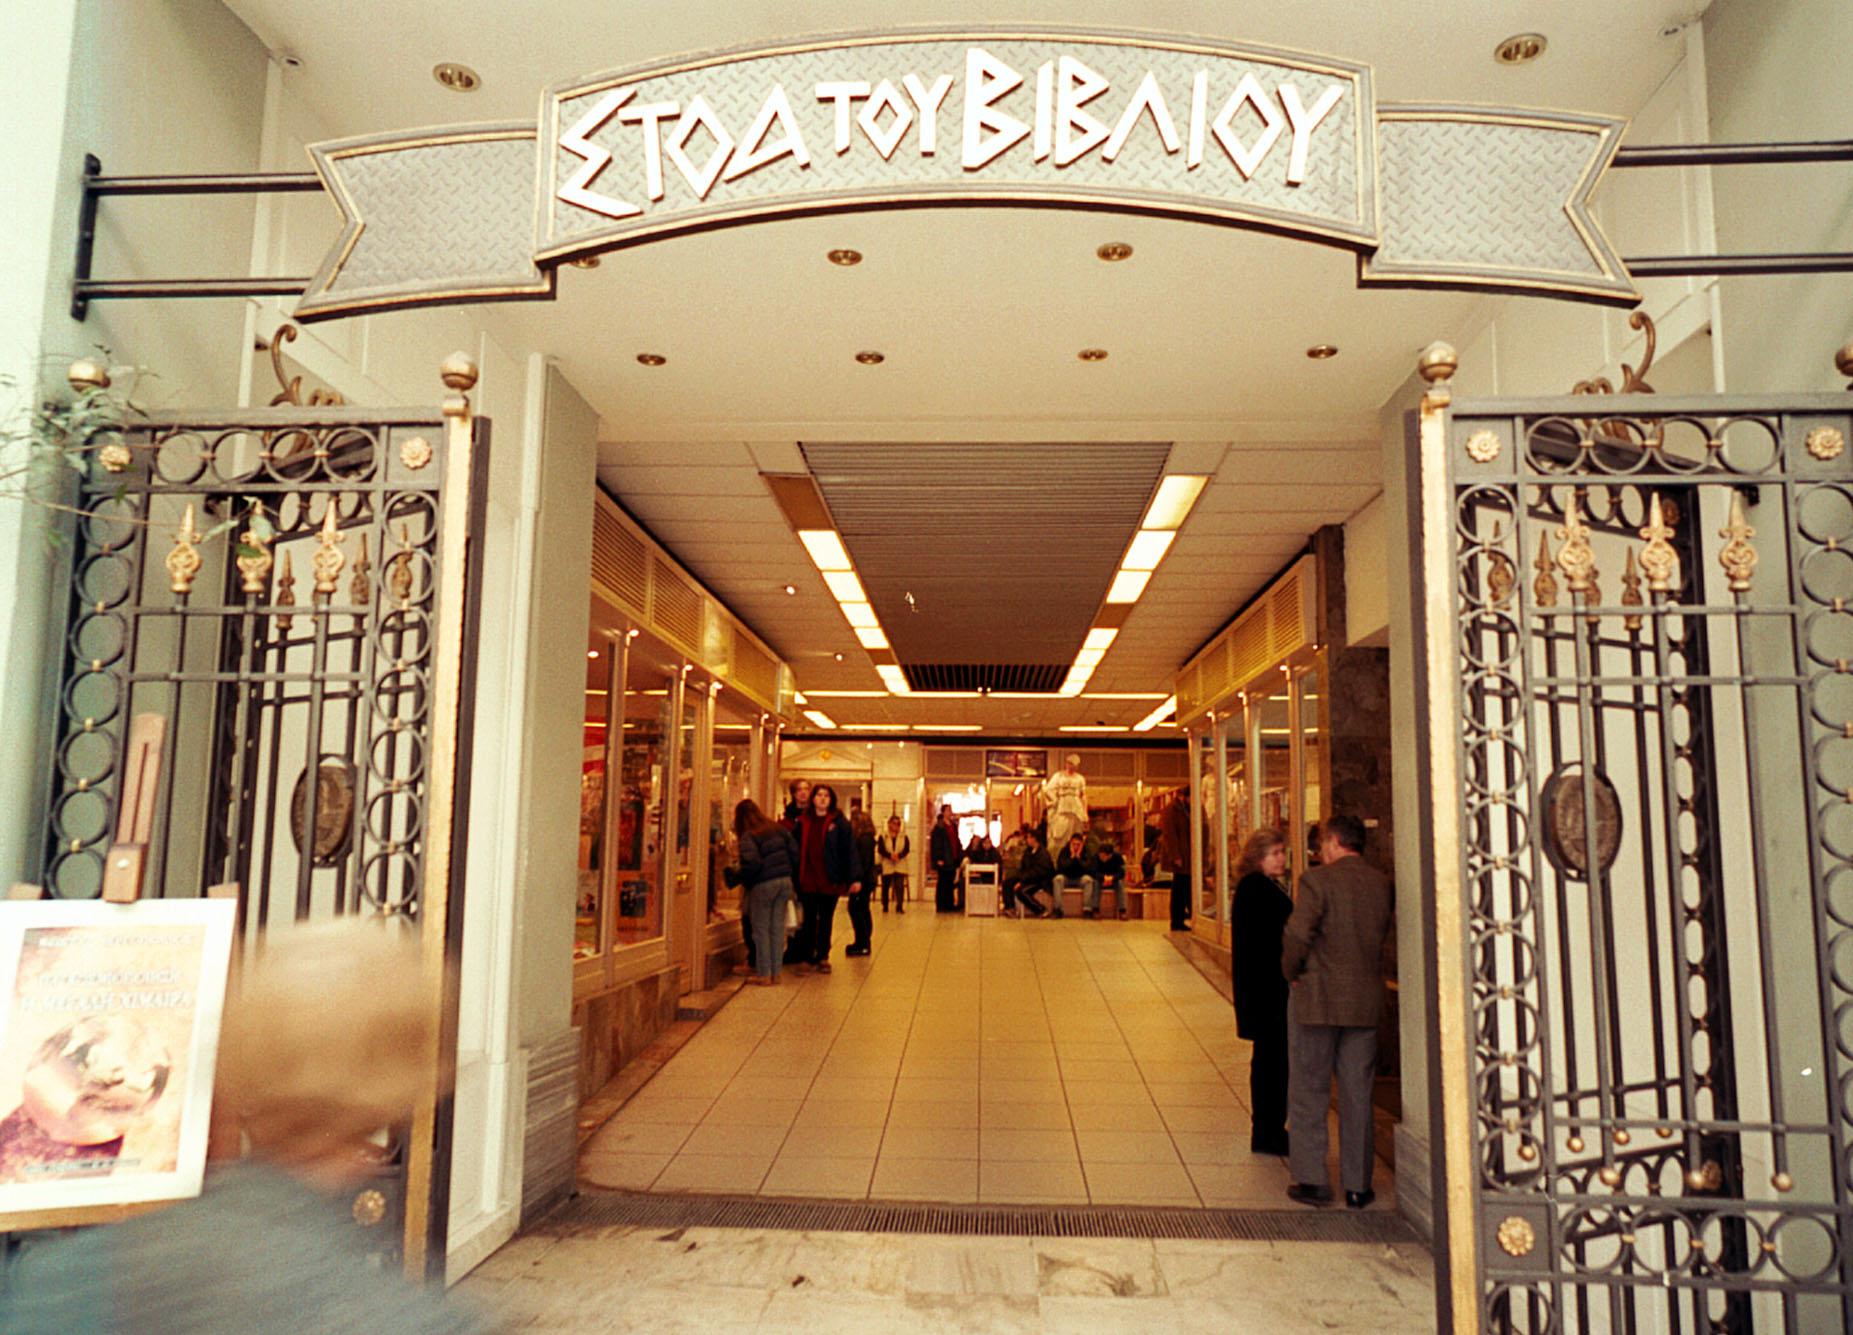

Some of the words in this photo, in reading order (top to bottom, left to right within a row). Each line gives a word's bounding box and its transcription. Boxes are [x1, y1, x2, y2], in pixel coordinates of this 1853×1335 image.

[556, 85, 810, 218] ΣΤΟΑ
[815, 74, 954, 156] ΤΟΥ
[961, 47, 1344, 186] ΒΙΒΛΙΟΥ
